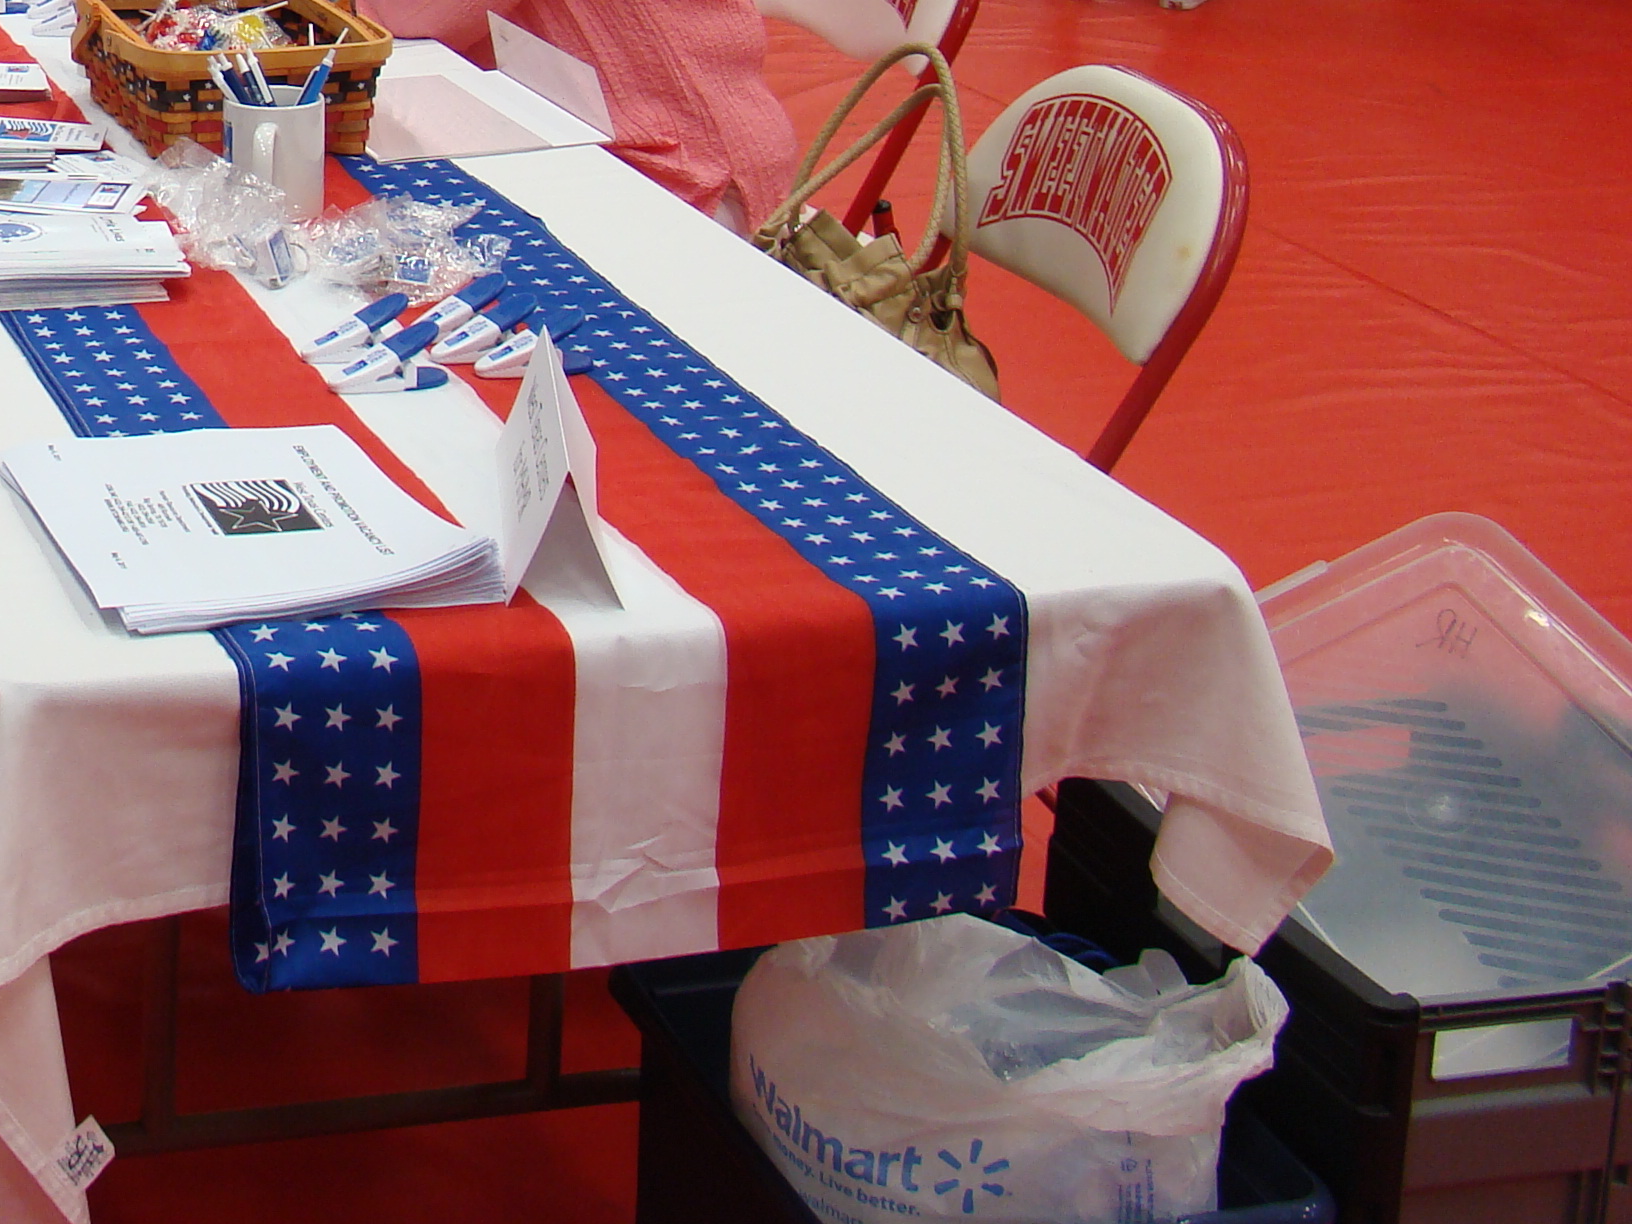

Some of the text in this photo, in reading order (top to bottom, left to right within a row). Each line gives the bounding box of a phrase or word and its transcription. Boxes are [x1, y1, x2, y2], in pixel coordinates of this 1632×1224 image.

[749, 1052, 924, 1193] Walmart
[819, 1170, 854, 1197] Live
[855, 1187, 921, 1217] better.
